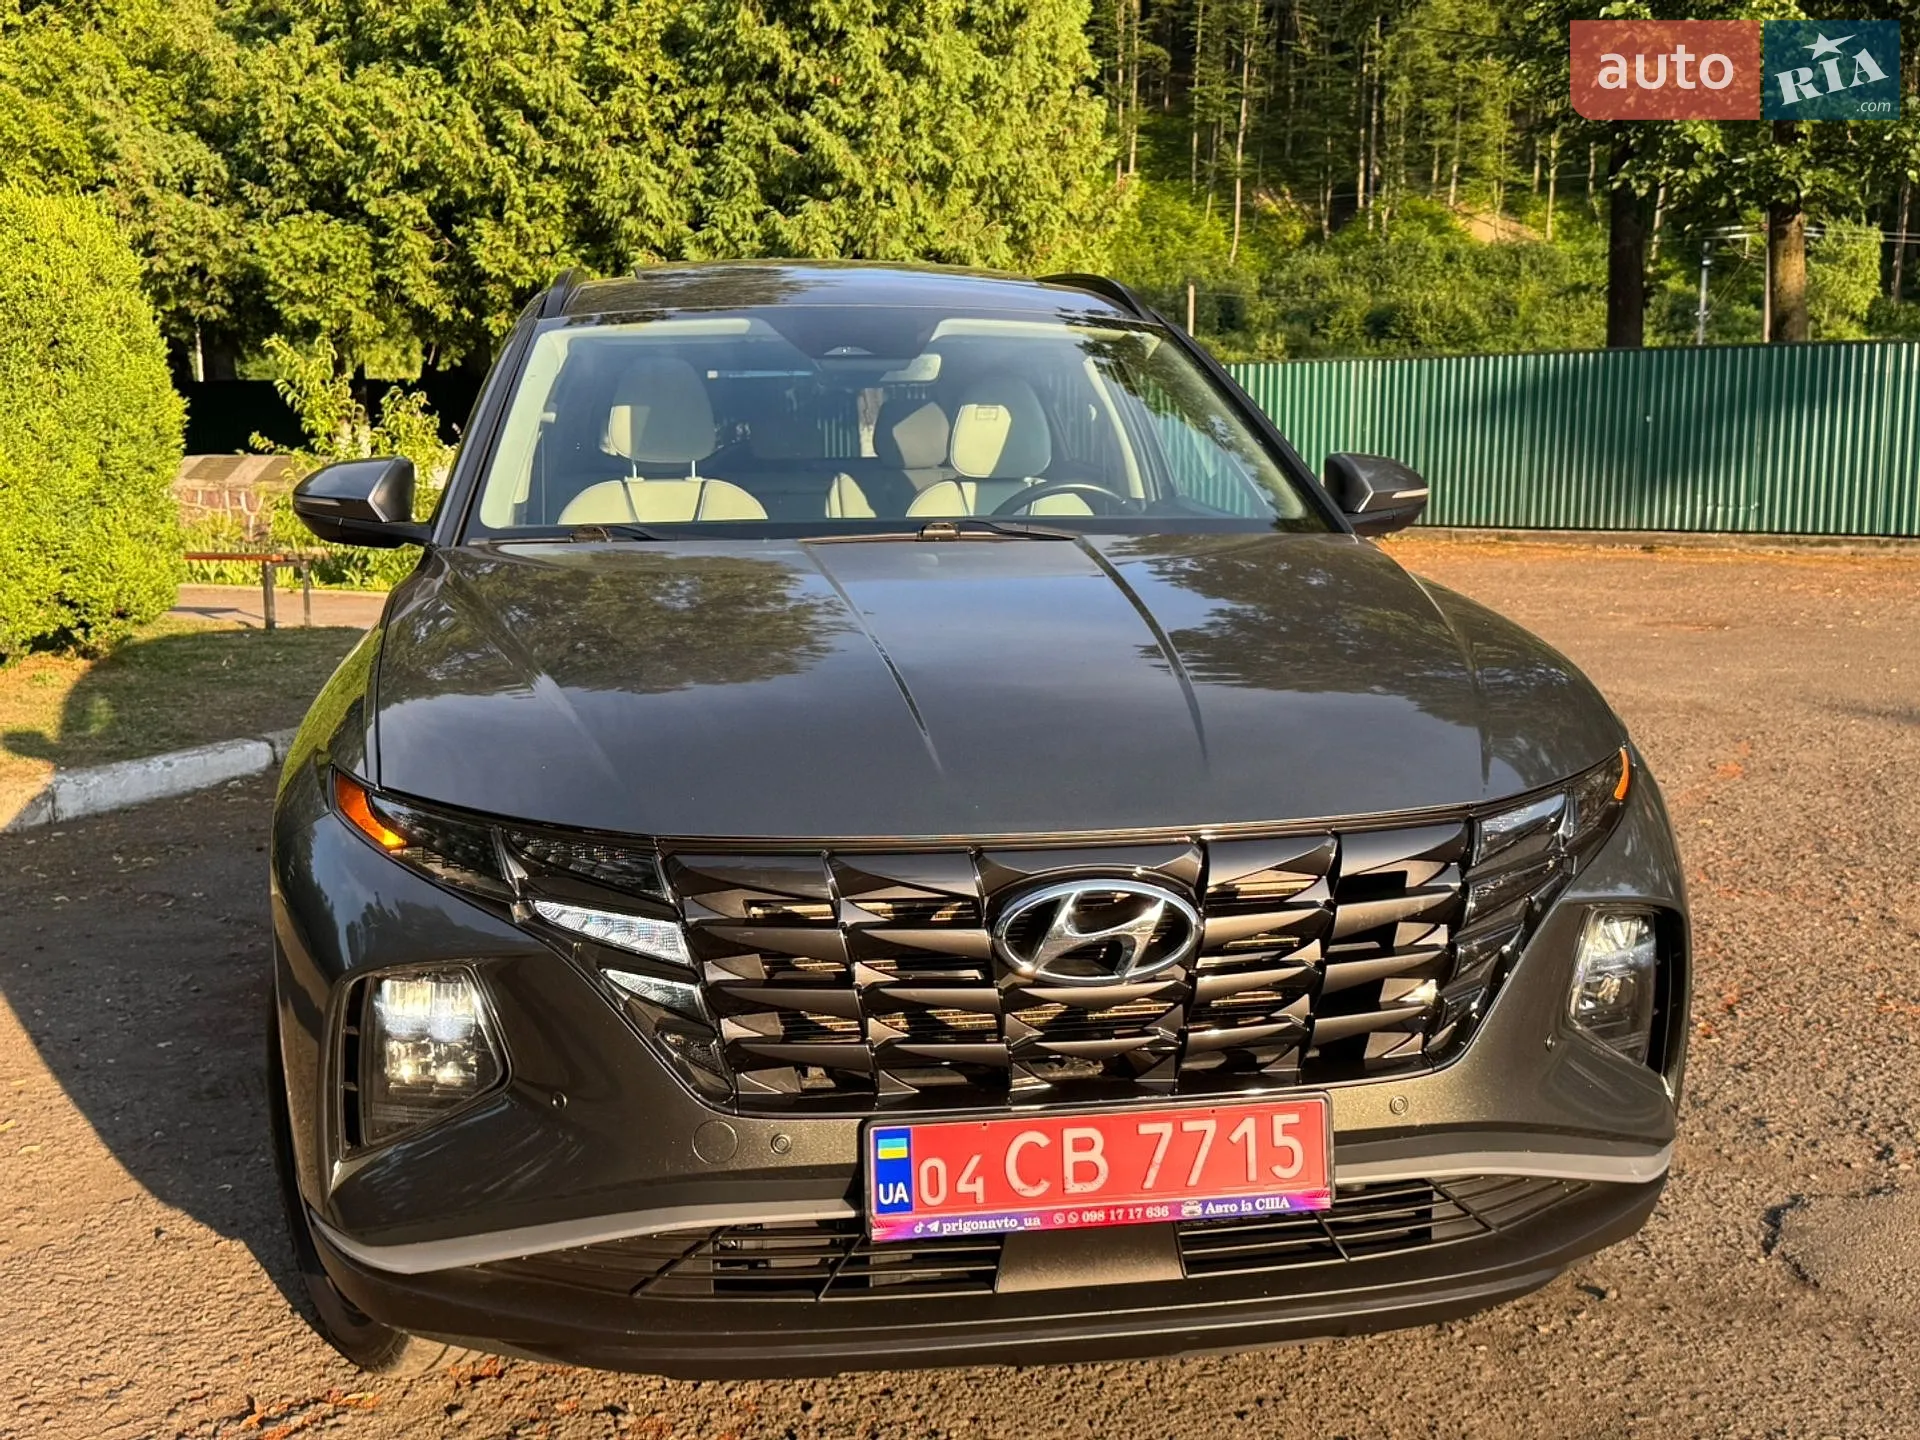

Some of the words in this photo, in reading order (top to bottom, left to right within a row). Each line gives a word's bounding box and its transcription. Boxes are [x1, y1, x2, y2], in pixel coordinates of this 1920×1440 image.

[918, 1153, 986, 1207] 04
[1004, 1126, 1109, 1198] CB
[1137, 1113, 1304, 1190] 7715
[878, 1182, 910, 1205] UA
[1081, 1209, 1106, 1223] 098
[1109, 1208, 1124, 1222] 17
[1128, 1207, 1143, 1220] 17
[1205, 1200, 1238, 1215] Авто
[1255, 1195, 1291, 1212] США
[942, 1214, 1041, 1235] prigonavto_ua
